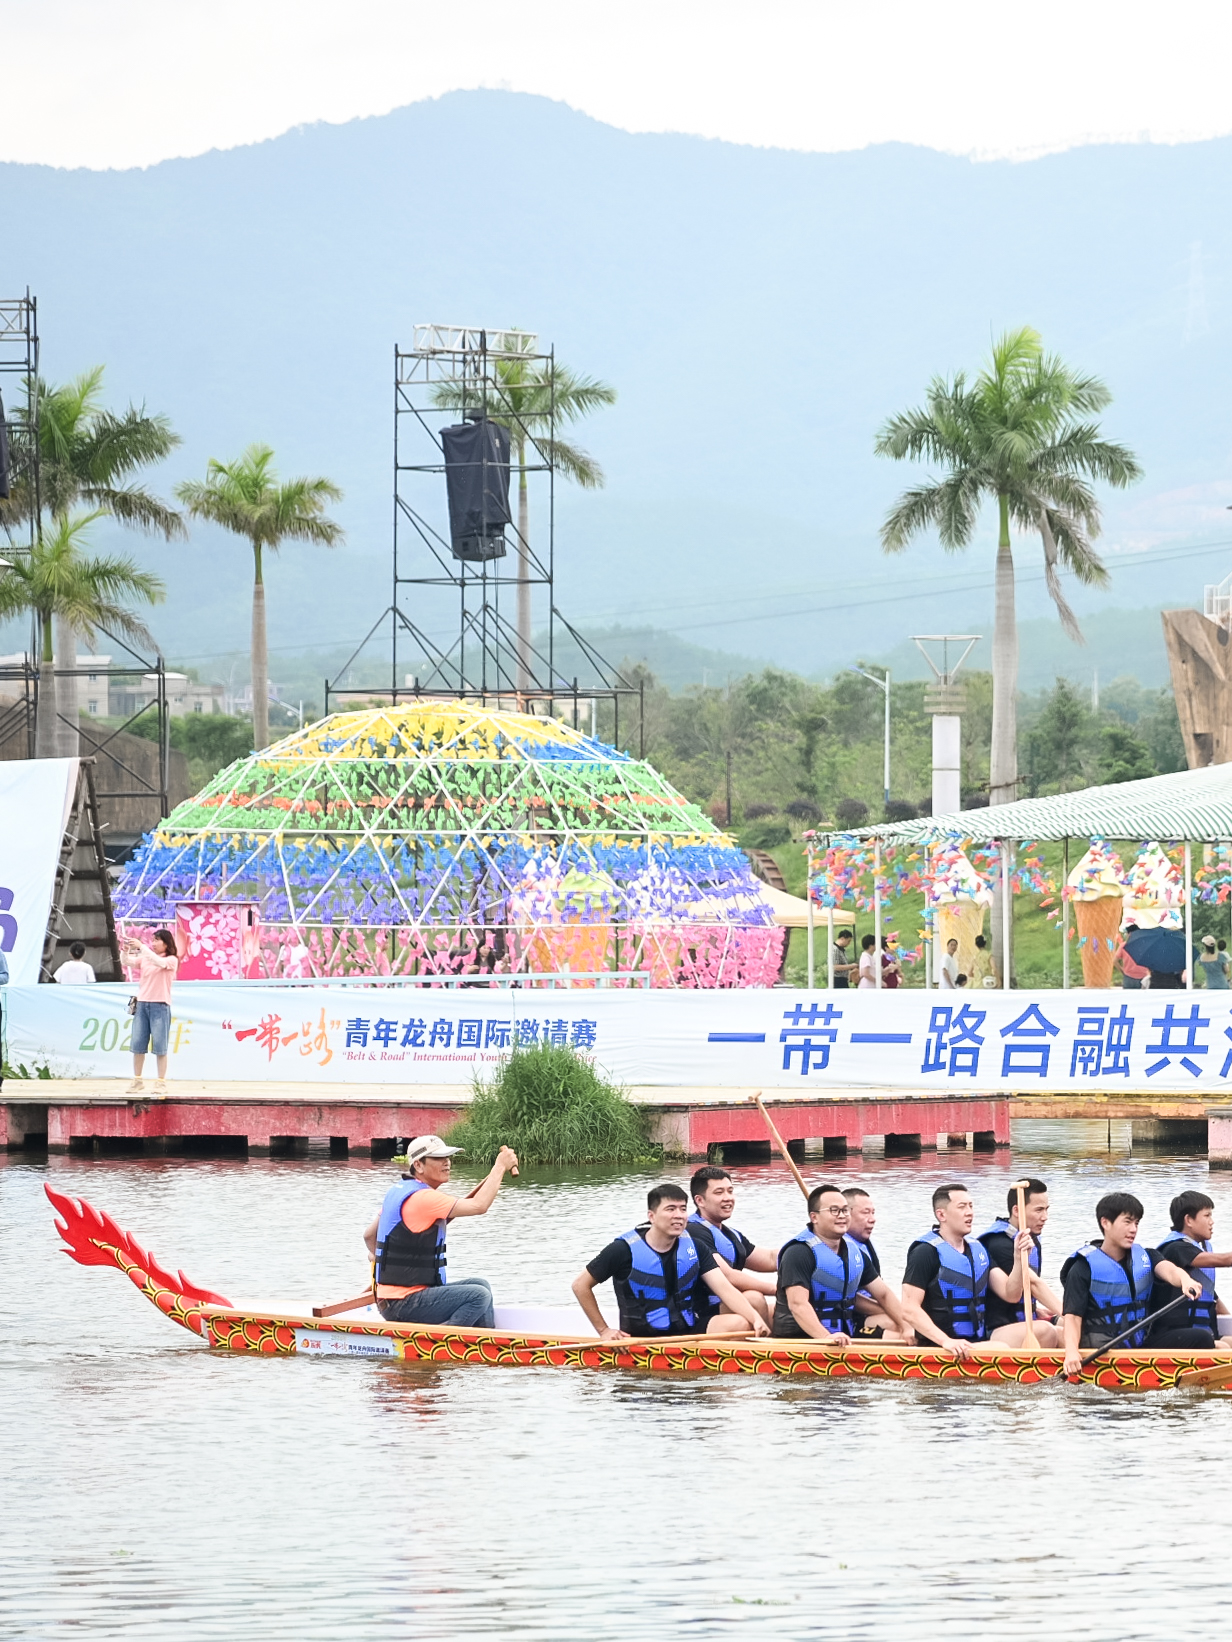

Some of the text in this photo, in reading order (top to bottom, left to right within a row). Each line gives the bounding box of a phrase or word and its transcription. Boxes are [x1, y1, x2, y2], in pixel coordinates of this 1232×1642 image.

[79, 1017, 194, 1055] 202年
[345, 1017, 597, 1049] 青年龙舟国际邀请赛
[368, 1051, 378, 1061] &
[413, 1051, 476, 1062] International
